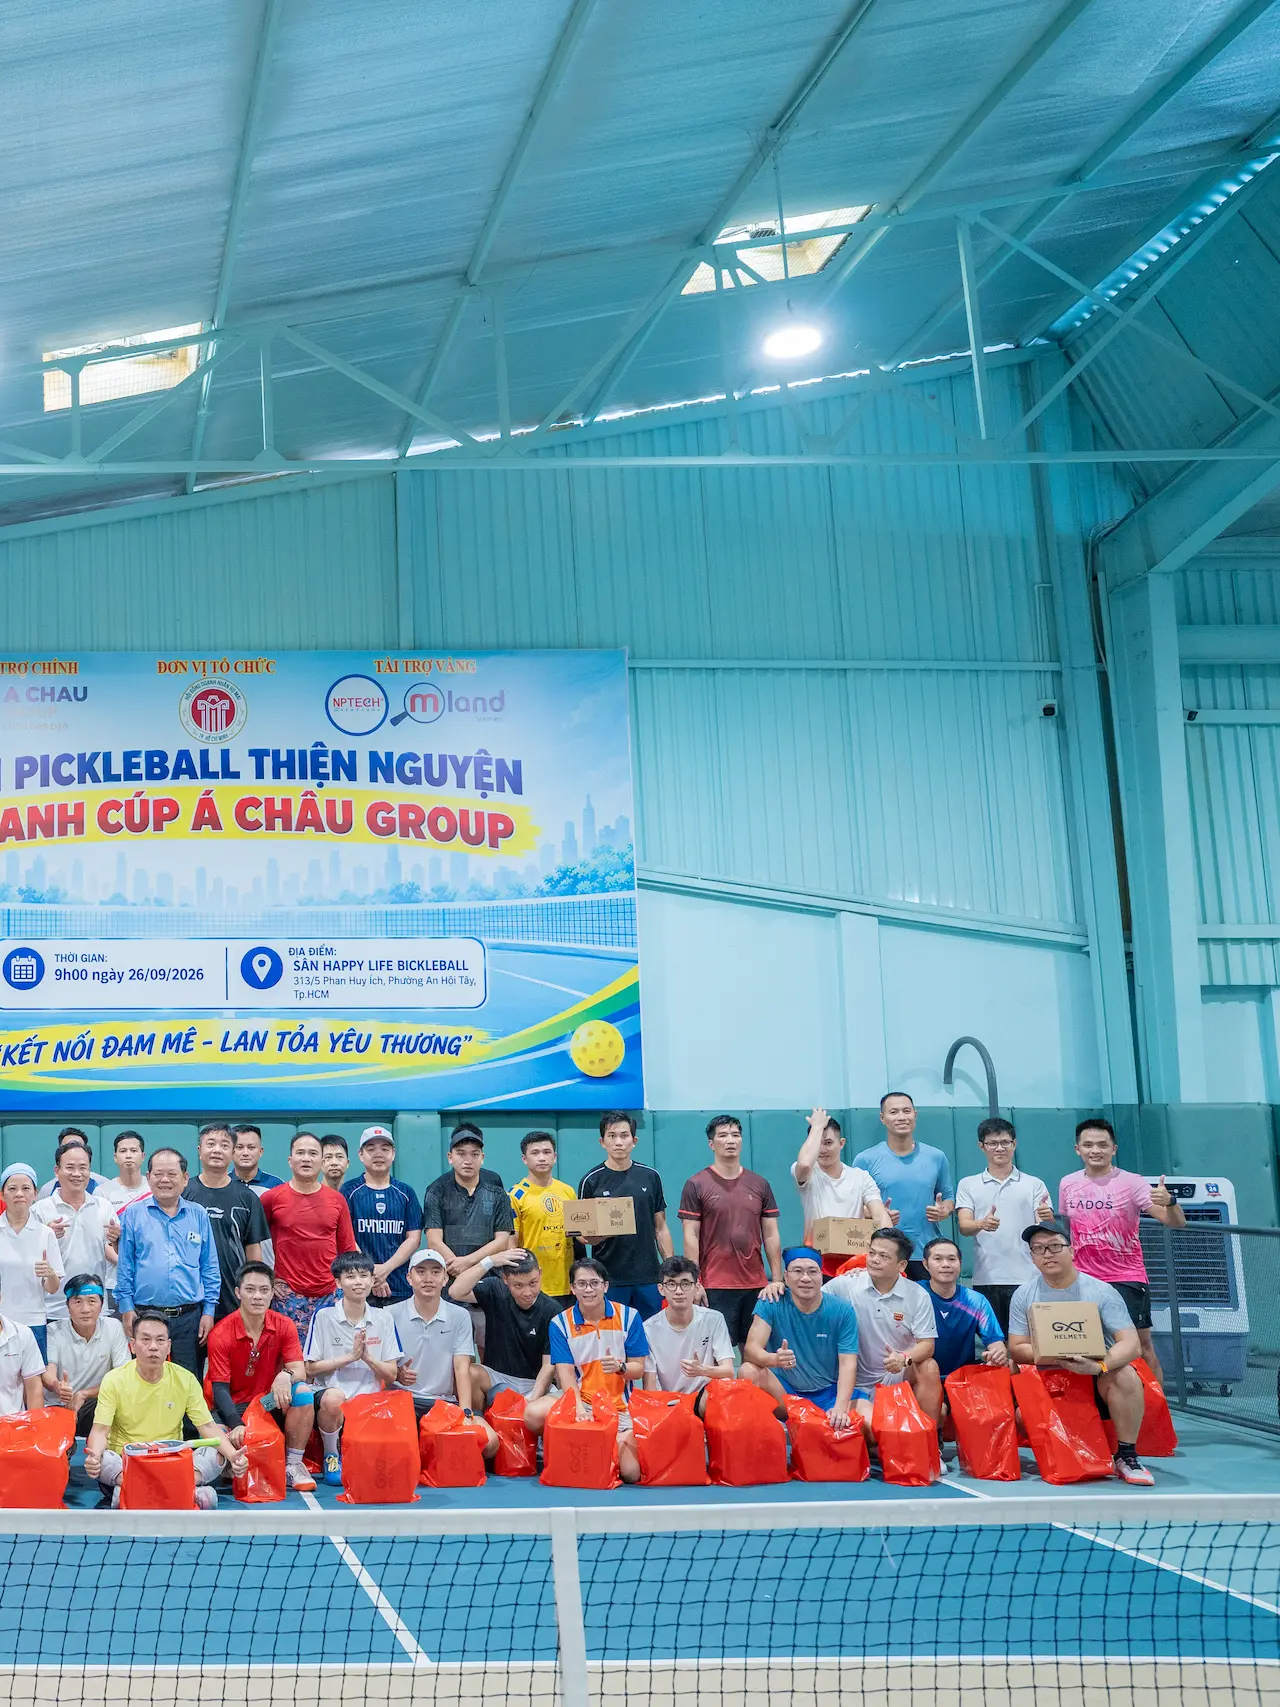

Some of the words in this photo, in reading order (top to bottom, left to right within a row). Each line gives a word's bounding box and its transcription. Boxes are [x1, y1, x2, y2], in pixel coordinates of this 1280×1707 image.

[31, 658, 79, 675] CHÍNH
[157, 659, 188, 674] ĐƠN
[192, 660, 207, 677] VỊ
[233, 657, 276, 674] CHỨC
[374, 657, 400, 673] TÀI
[402, 659, 433, 676] TRỢ
[436, 657, 476, 673] VÀNG
[3, 686, 20, 702] A
[26, 686, 88, 702] CHAU
[333, 697, 380, 708] NPTECH
[15, 749, 241, 790] PICKLEBALL
[248, 741, 357, 788] THIỆN
[369, 748, 524, 799] NGUYỆN
[97, 791, 180, 834] CÚP
[190, 790, 224, 831] Á
[234, 790, 353, 834] CHÂU
[366, 801, 515, 849] GROUP
[54, 951, 78, 963] THỜI
[81, 953, 108, 963] GIAN:
[288, 947, 306, 958] ĐỊA
[308, 943, 337, 956] ĐIỂM:
[293, 957, 318, 972] SÂN
[323, 960, 364, 971] HAPPY
[368, 960, 393, 971] LIFE
[397, 960, 469, 971] BICKLEBALL
[54, 968, 88, 981] 9h00
[92, 967, 125, 984] ngày
[128, 968, 204, 982] 26/09/2026
[293, 976, 321, 986] 313/5
[323, 976, 347, 985] Phan
[349, 976, 367, 988] Huy
[388, 974, 424, 988] Phường
[426, 976, 439, 985] An
[459, 976, 477, 987] Tây,
[293, 989, 330, 1000] Tp.HCM
[52, 1030, 95, 1063] NỐI
[101, 1032, 156, 1059] ĐAM
[161, 1026, 198, 1054] MÊ
[220, 1030, 269, 1052] LAN
[276, 1023, 319, 1053] TỎA
[329, 1028, 373, 1054] YÊU
[1070, 1200, 1113, 1210] LADOS
[357, 1218, 405, 1235] DYNAMIC
[847, 1239, 865, 1248] Royal
[1052, 1321, 1085, 1333] GXT
